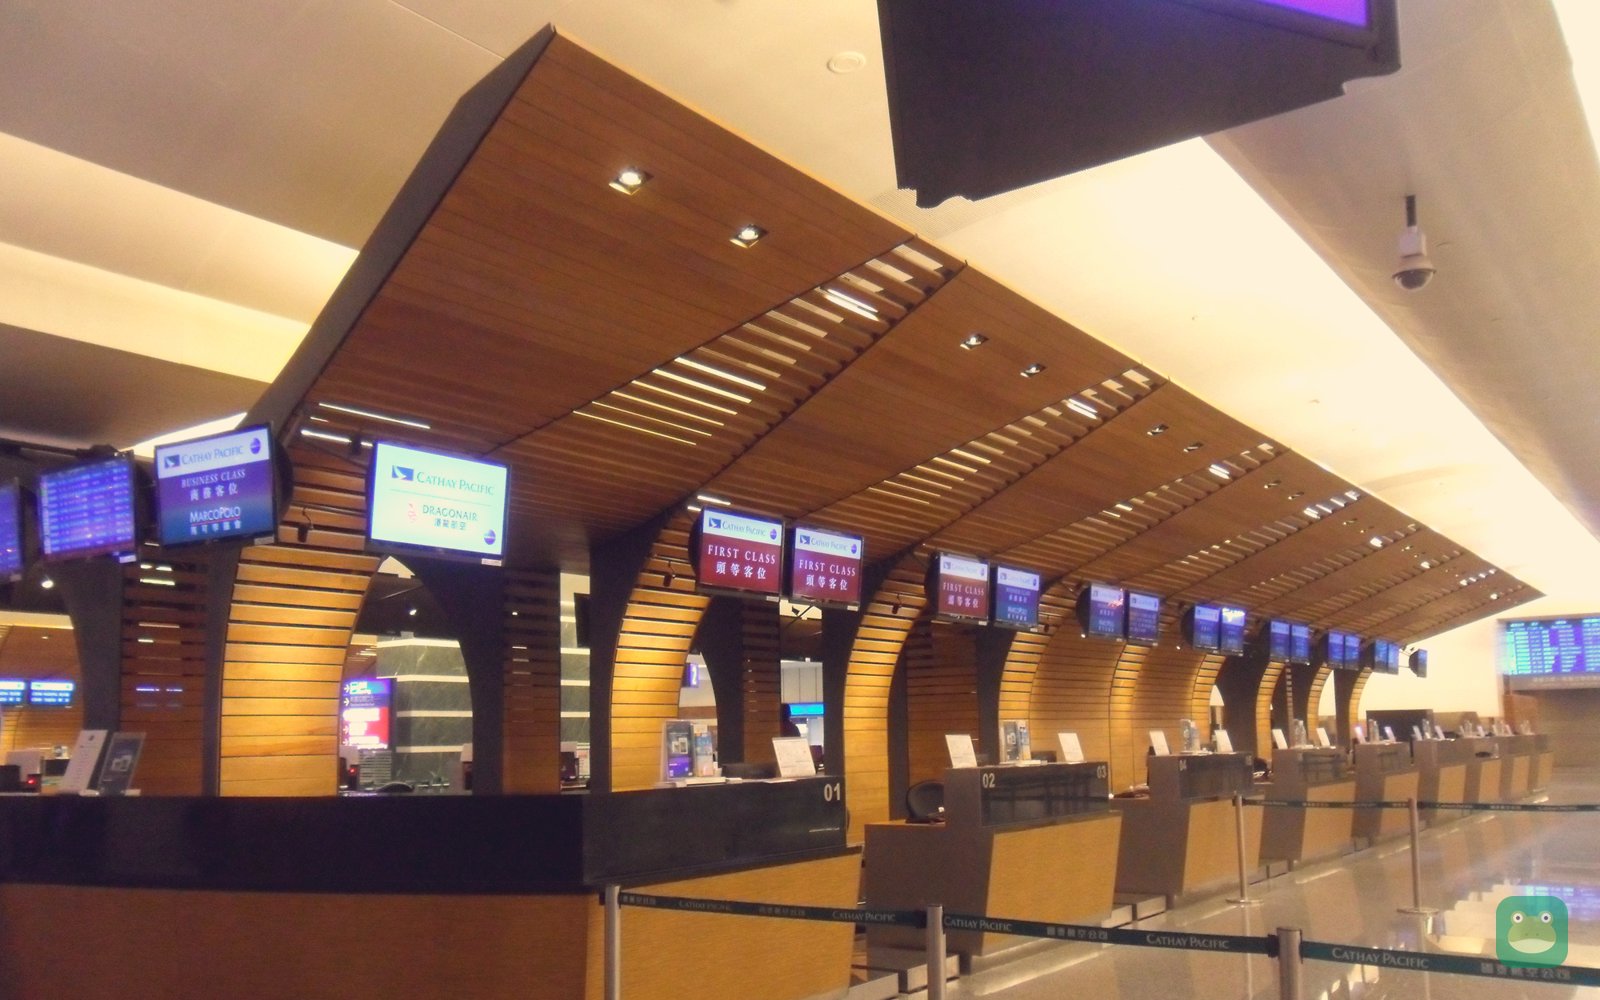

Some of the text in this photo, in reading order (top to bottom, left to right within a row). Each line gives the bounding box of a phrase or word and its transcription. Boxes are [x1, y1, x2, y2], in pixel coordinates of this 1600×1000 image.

[220, 469, 246, 482] CLASS
[416, 471, 495, 496] CATHAY PACIFIC
[422, 504, 478, 521] DRAGONAIR
[708, 544, 776, 565] FIRST CLASS
[716, 561, 767, 580] 頭等客位
[799, 559, 856, 577] FIRST CLASS
[943, 582, 985, 596] FIRST CLASS
[1096, 765, 1107, 779] 03
[982, 773, 996, 789] 02
[824, 783, 841, 801] 01
[832, 911, 896, 922] CATHAY PACIFIC
[944, 916, 1012, 931] CATHAY PACIFIC
[1146, 934, 1229, 949] CATHAY PACIFIC
[1332, 948, 1429, 969] CATHAY PACIFIC
